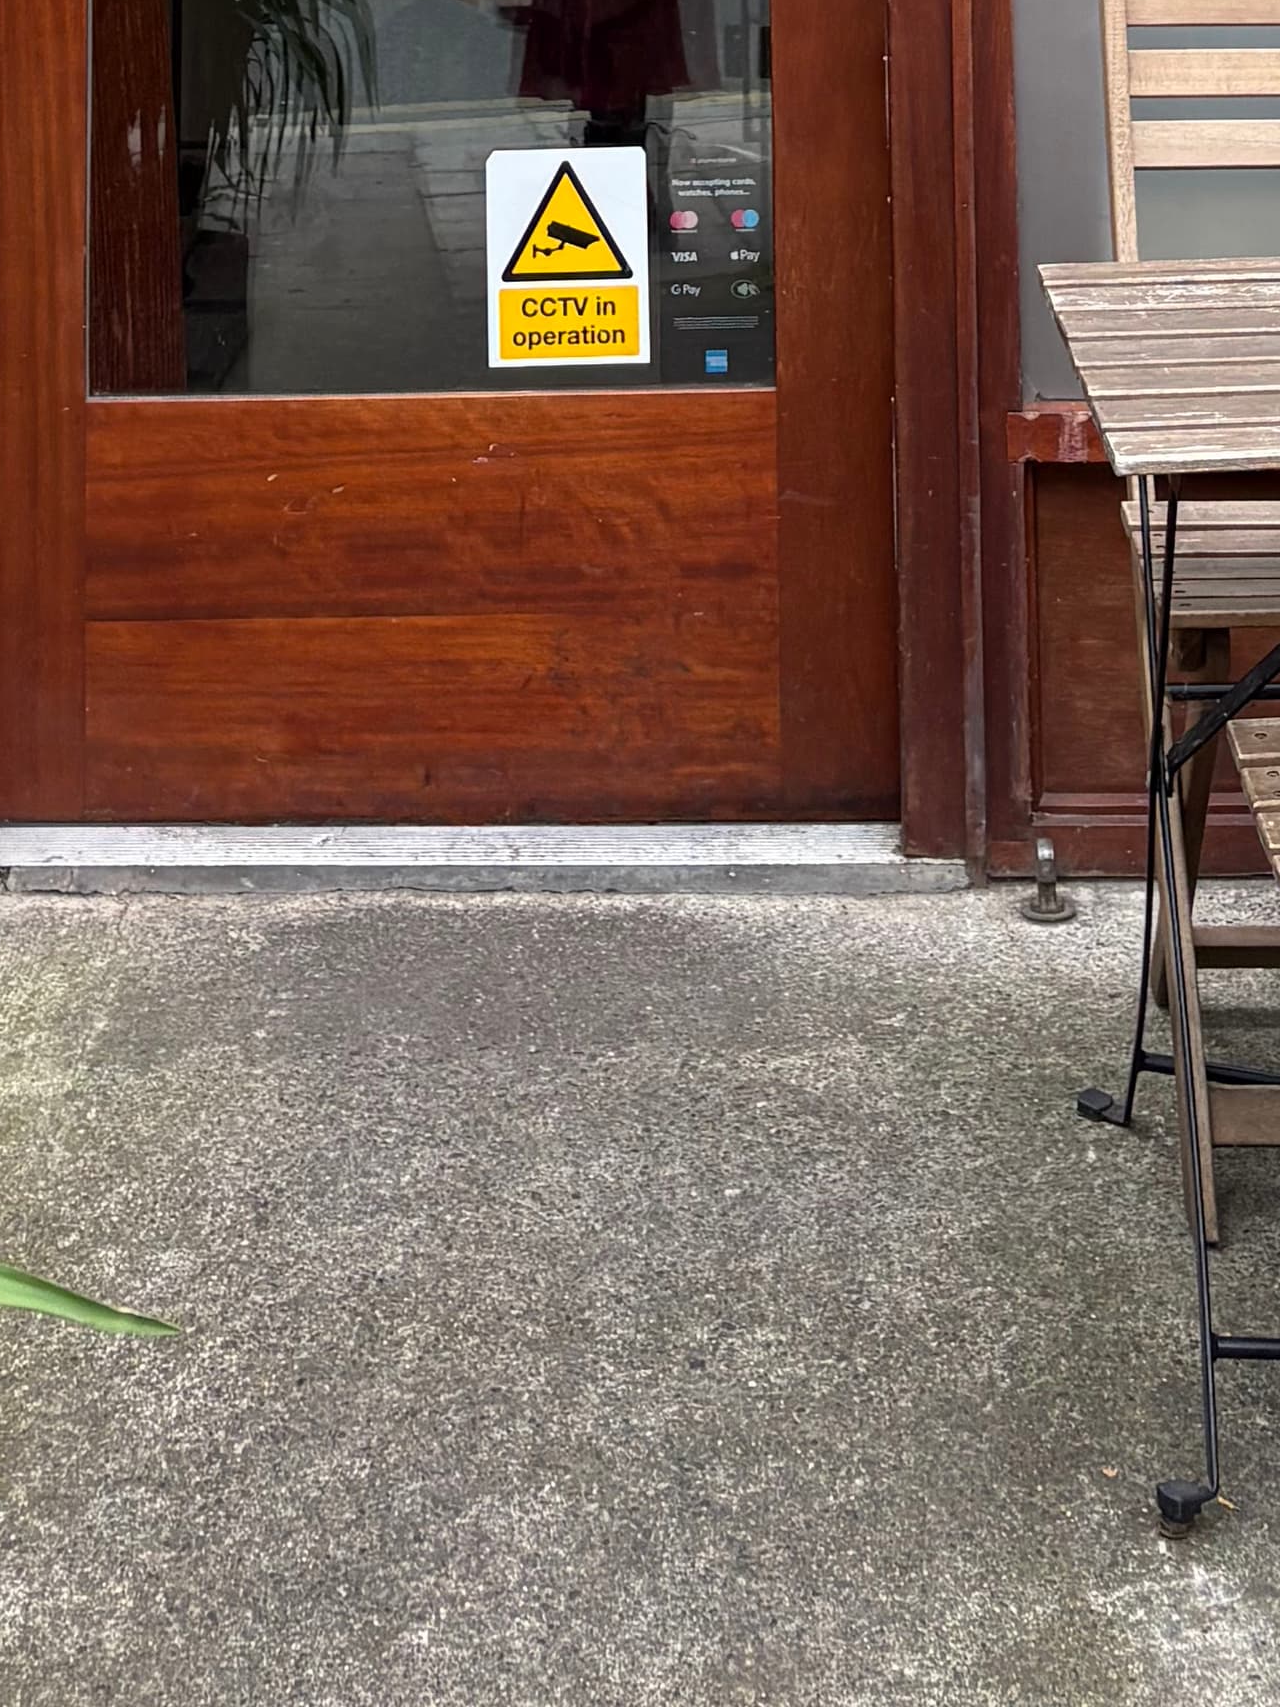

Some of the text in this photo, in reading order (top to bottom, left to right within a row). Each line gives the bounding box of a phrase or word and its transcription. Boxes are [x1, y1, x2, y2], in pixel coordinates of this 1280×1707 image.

[671, 251, 698, 262] VISA
[739, 249, 761, 262] Pay
[683, 284, 701, 297] Pay
[521, 296, 616, 319] CCTV in
[512, 326, 626, 350] operation
